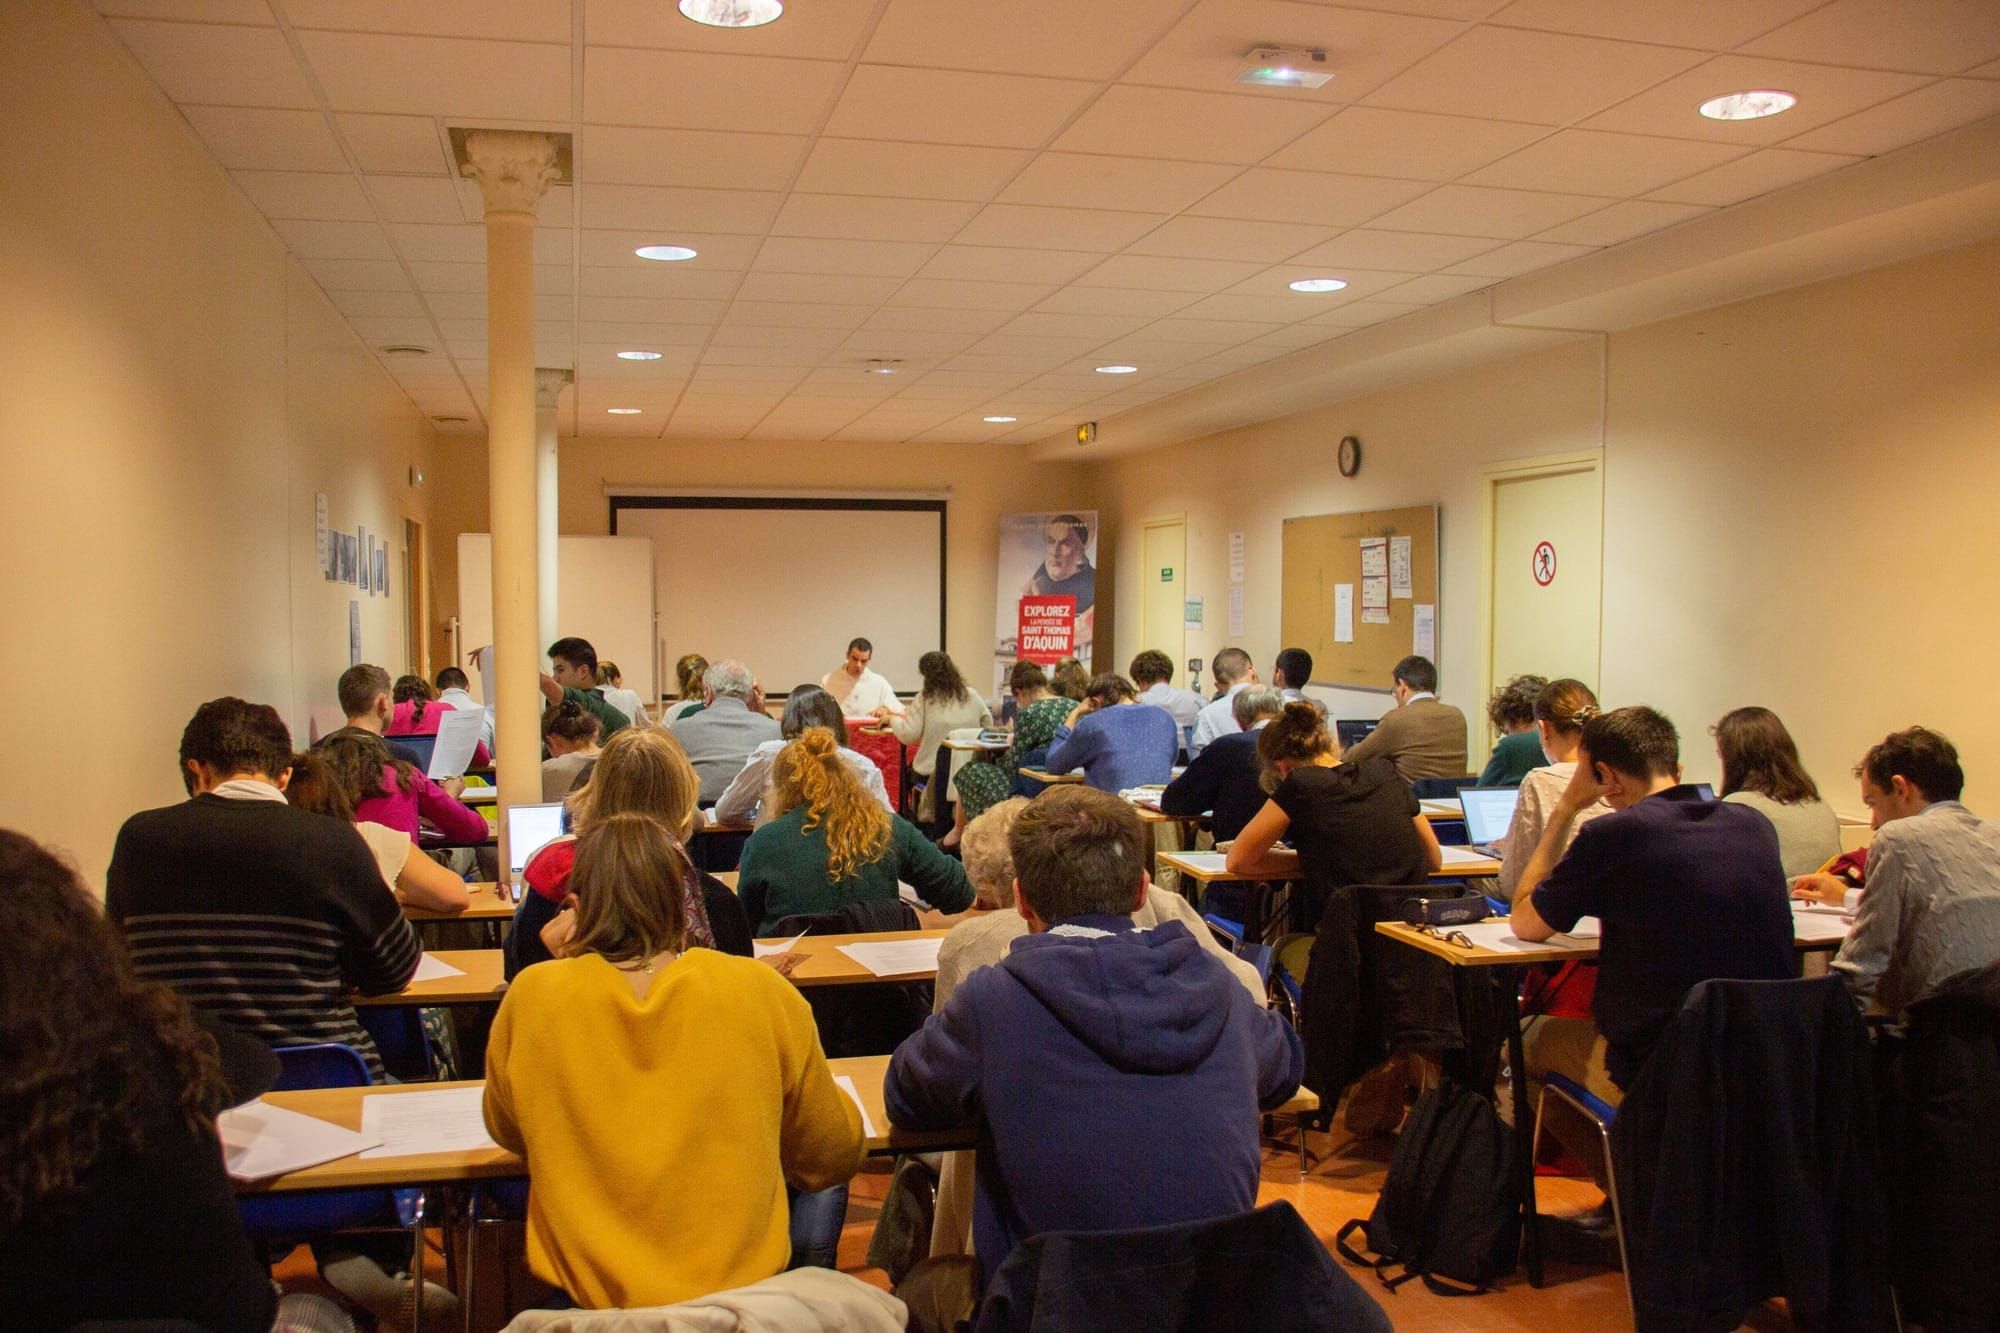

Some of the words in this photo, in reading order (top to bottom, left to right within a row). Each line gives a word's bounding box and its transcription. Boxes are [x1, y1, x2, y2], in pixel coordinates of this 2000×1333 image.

[1024, 605, 1071, 617] EXPLOREZ
[1021, 626, 1041, 635] SAINT
[1043, 626, 1071, 635] THOMAS
[1023, 635, 1068, 652] D'AQUIN
